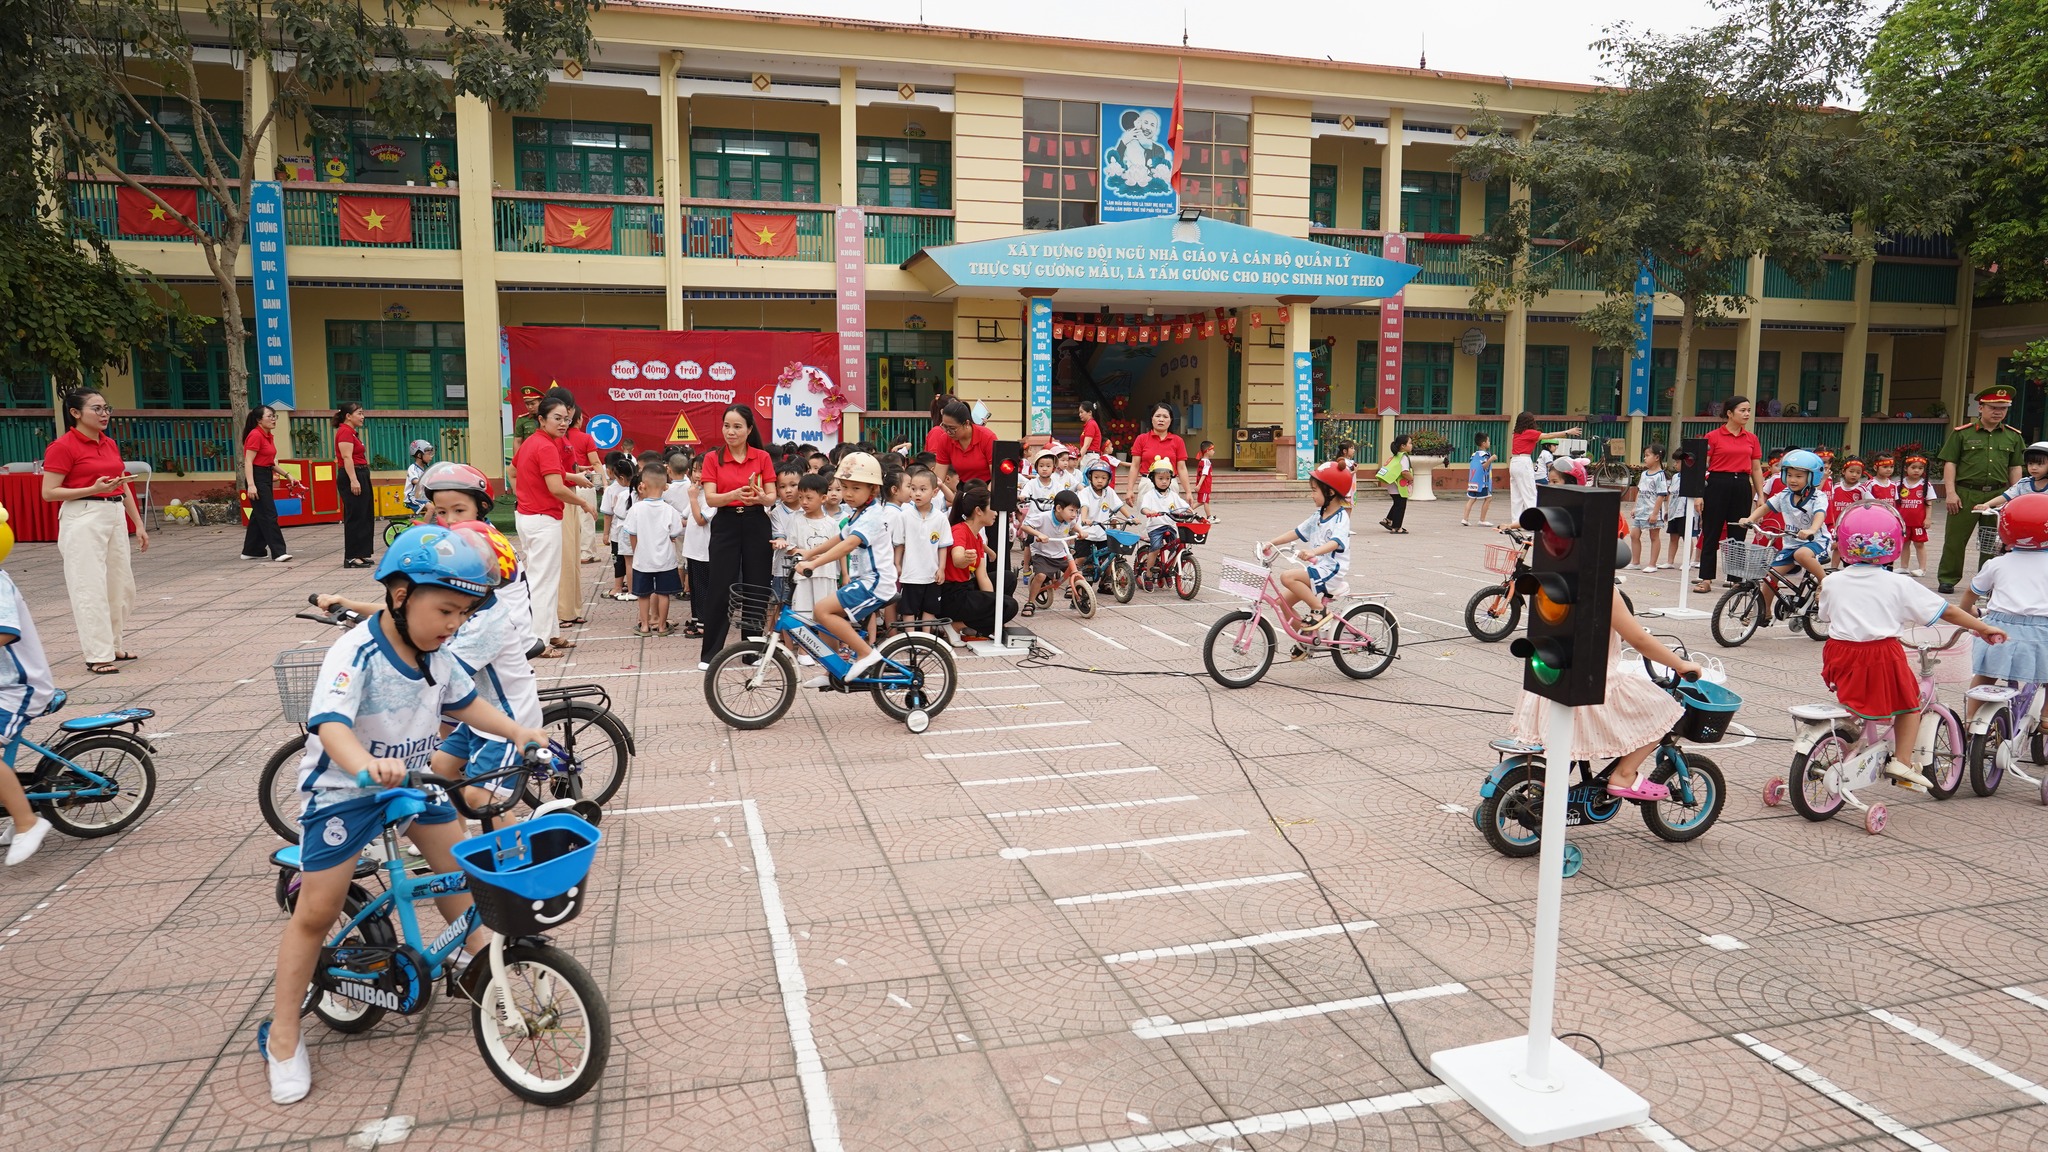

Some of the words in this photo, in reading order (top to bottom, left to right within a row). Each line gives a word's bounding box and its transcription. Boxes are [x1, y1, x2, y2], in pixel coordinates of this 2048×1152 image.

[330, 162, 341, 171] BÉ
[256, 200, 275, 214] CHẤT
[255, 221, 278, 235] LƯỢNG
[260, 240, 277, 252] GIÁO
[844, 236, 856, 244] VỌT
[1007, 241, 1040, 257] XÂY
[1042, 243, 1084, 260] DỰNG
[1087, 244, 1112, 261] ĐỘI
[1115, 245, 1146, 261] NGŨ
[1149, 246, 1179, 261] NHÀ
[1182, 247, 1217, 262] GIÁO
[1220, 249, 1239, 264] VÀ
[1242, 250, 1271, 265] CÁN
[1274, 251, 1292, 268] BỘ
[1294, 250, 1332, 268] QUẢN
[1335, 253, 1352, 268] LÝ
[261, 260, 278, 273] DỤC,
[968, 260, 1010, 277] THỰC
[1012, 262, 1032, 279] SỰ
[1035, 262, 1085, 278] GƯƠNG
[1088, 260, 1124, 281] MẪU,
[1127, 263, 1148, 279] LÀ
[1149, 263, 1180, 281] TẤM
[1182, 266, 1230, 282] GƯƠNG
[1232, 270, 1260, 283] CHO
[1262, 272, 1289, 286] HỌC
[1292, 273, 1323, 286] SINH
[1325, 274, 1348, 286] NOI
[1351, 275, 1385, 287] THEO
[266, 278, 275, 290] LÀ
[262, 298, 281, 310] DANH
[268, 316, 279, 330] DỰ
[267, 334, 282, 347] CỦA
[268, 354, 283, 366] NHÀ
[614, 365, 636, 376] Hoạt
[645, 363, 667, 376] động
[263, 372, 291, 385] TRƯỜNG
[658, 390, 679, 399] toàn
[758, 396, 773, 407] ST
[801, 431, 823, 441] NAM
[1914, 528, 1923, 536] 10
[430, 914, 468, 955] JINBAO
[335, 980, 399, 1011] JINBAO
